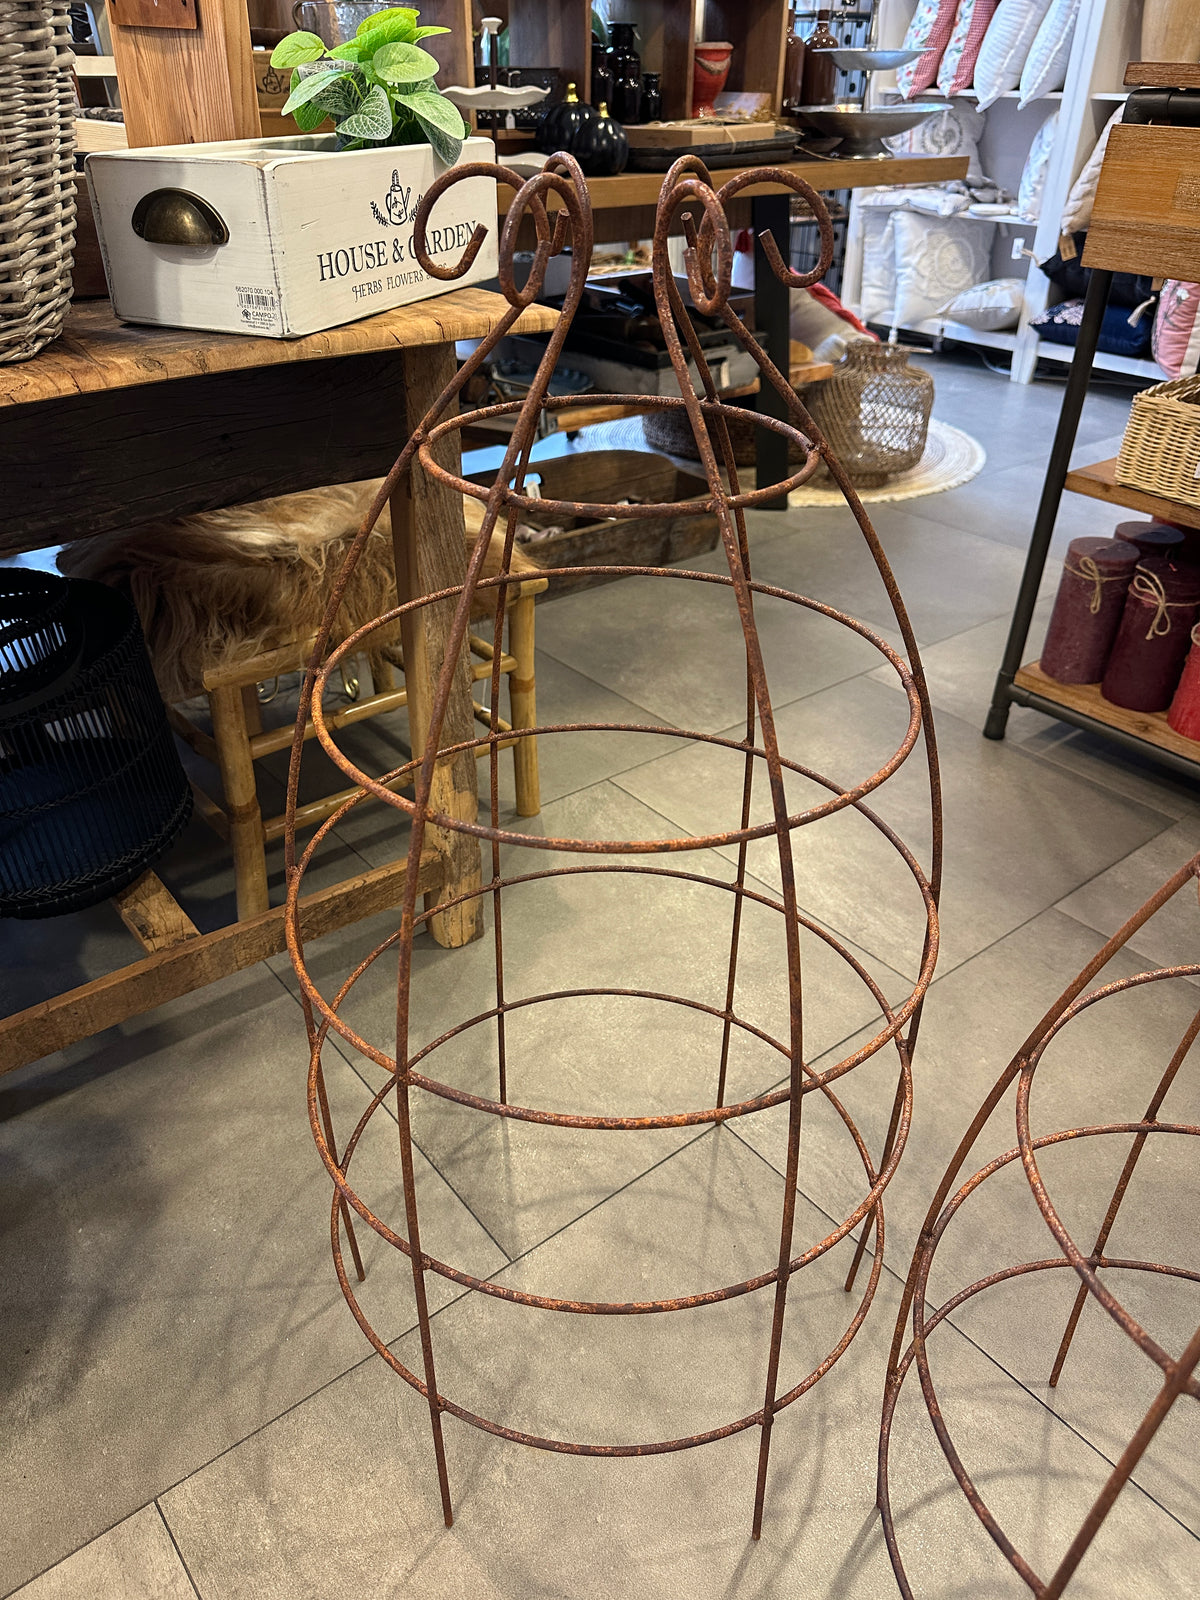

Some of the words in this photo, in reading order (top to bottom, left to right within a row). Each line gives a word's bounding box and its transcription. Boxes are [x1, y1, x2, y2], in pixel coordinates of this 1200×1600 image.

[317, 240, 388, 281] HOUSE
[392, 238, 404, 263] &
[351, 280, 383, 302] HERBS
[387, 269, 424, 290] FLOWERS
